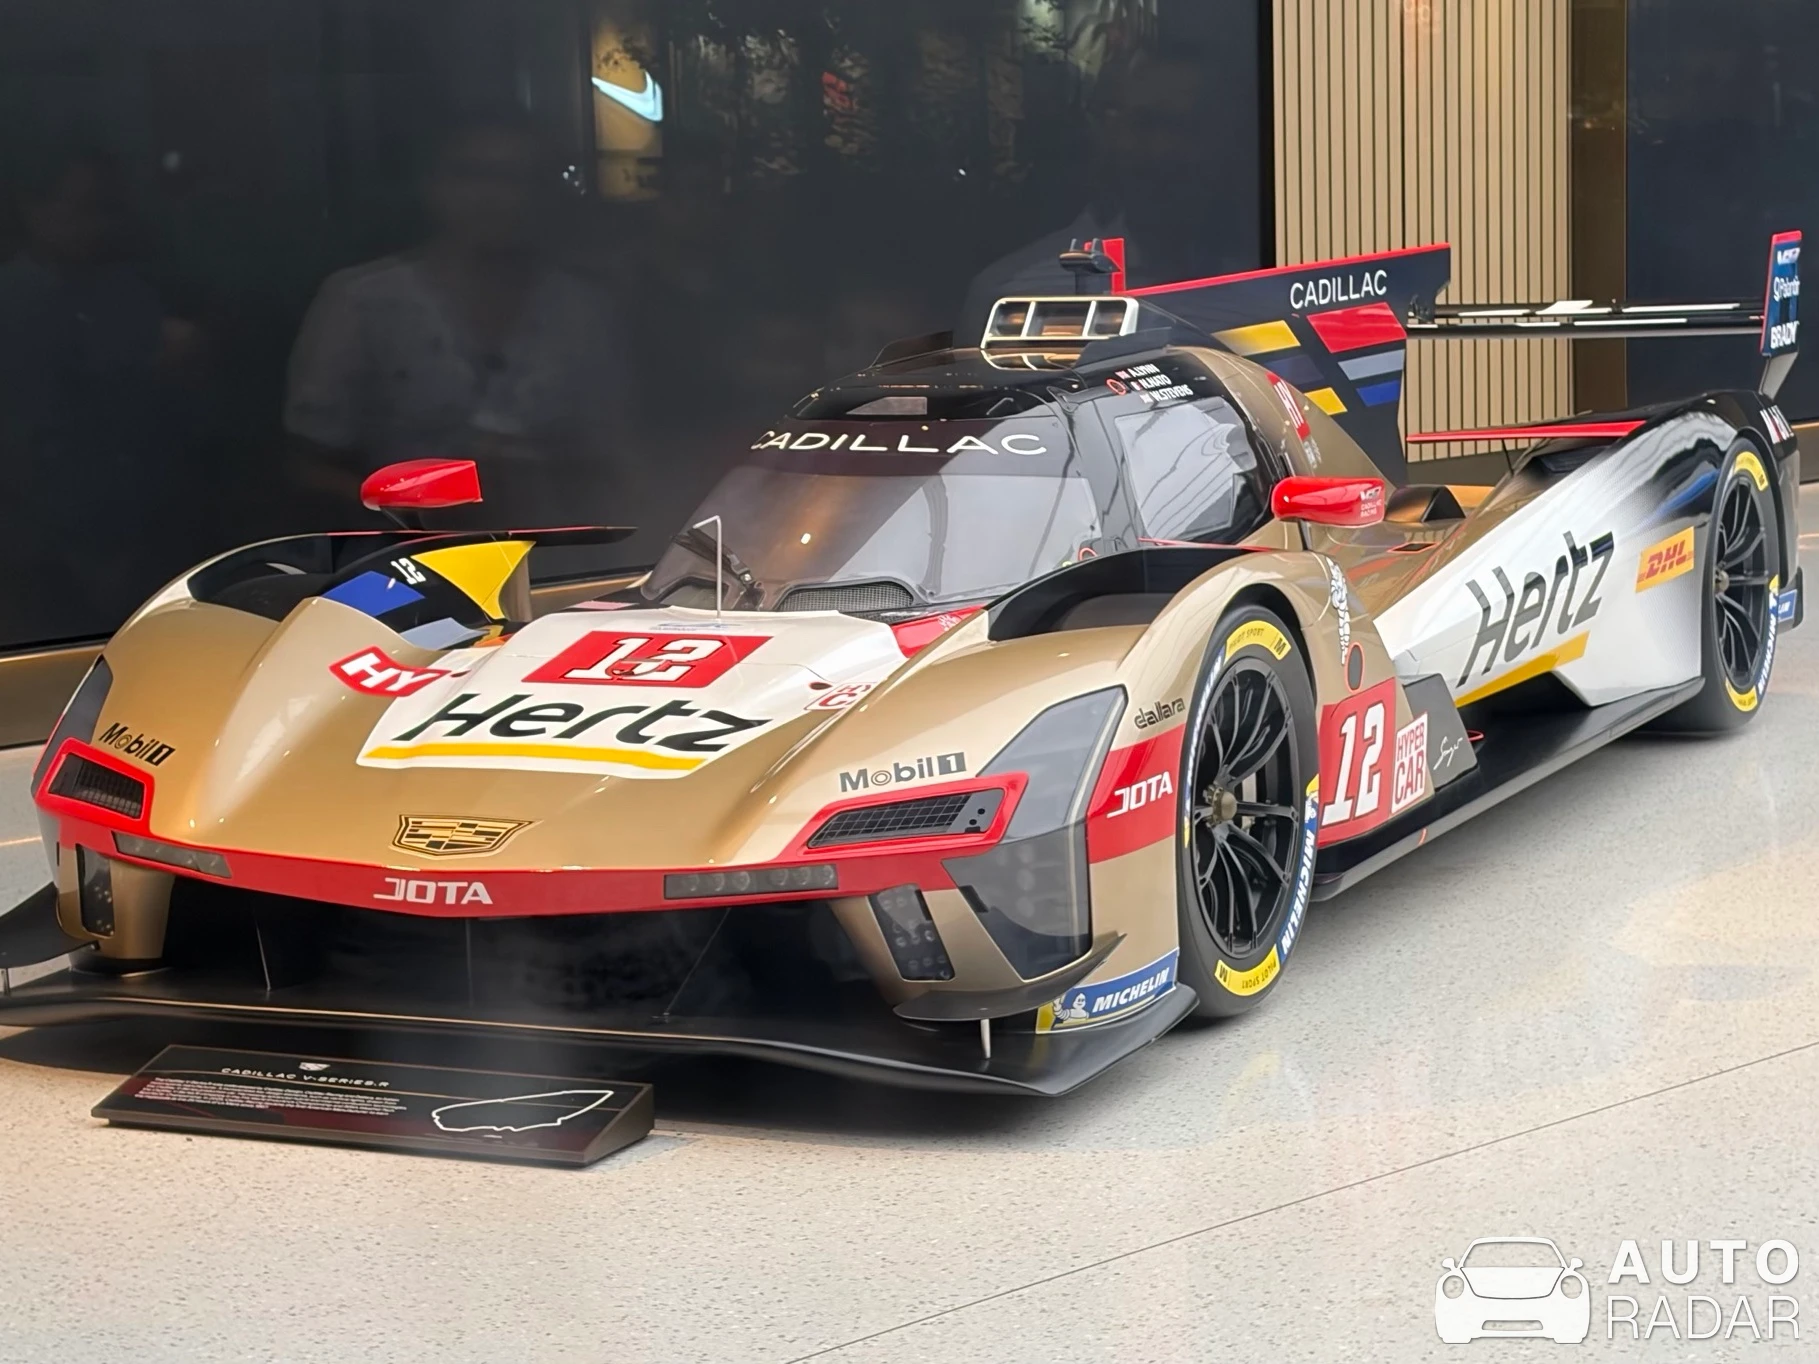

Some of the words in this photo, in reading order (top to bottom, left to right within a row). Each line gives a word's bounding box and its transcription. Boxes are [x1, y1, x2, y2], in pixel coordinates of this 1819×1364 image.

[1290, 269, 1387, 309] CADILLAC
[751, 430, 1047, 455] CADILLAC
[390, 558, 426, 585] 12
[1645, 540, 1687, 579] DHL
[1455, 530, 1615, 689] Hertz
[1246, 628, 1265, 638] SPORT
[341, 653, 440, 691] HY
[558, 636, 727, 682] 12
[390, 693, 773, 753] Hertz
[1134, 697, 1185, 729] dallara
[98, 722, 160, 759] Mobil
[1396, 722, 1425, 761] HYPER
[839, 757, 934, 792] Mobil
[1321, 700, 1385, 826] 12
[1395, 750, 1424, 804] CAR
[1106, 771, 1173, 819] JOTA
[373, 877, 493, 905] JOTA
[1282, 829, 1315, 955] MICHELIN
[1092, 967, 1169, 1013] MICHELIN
[221, 1067, 297, 1079] CADILLAC
